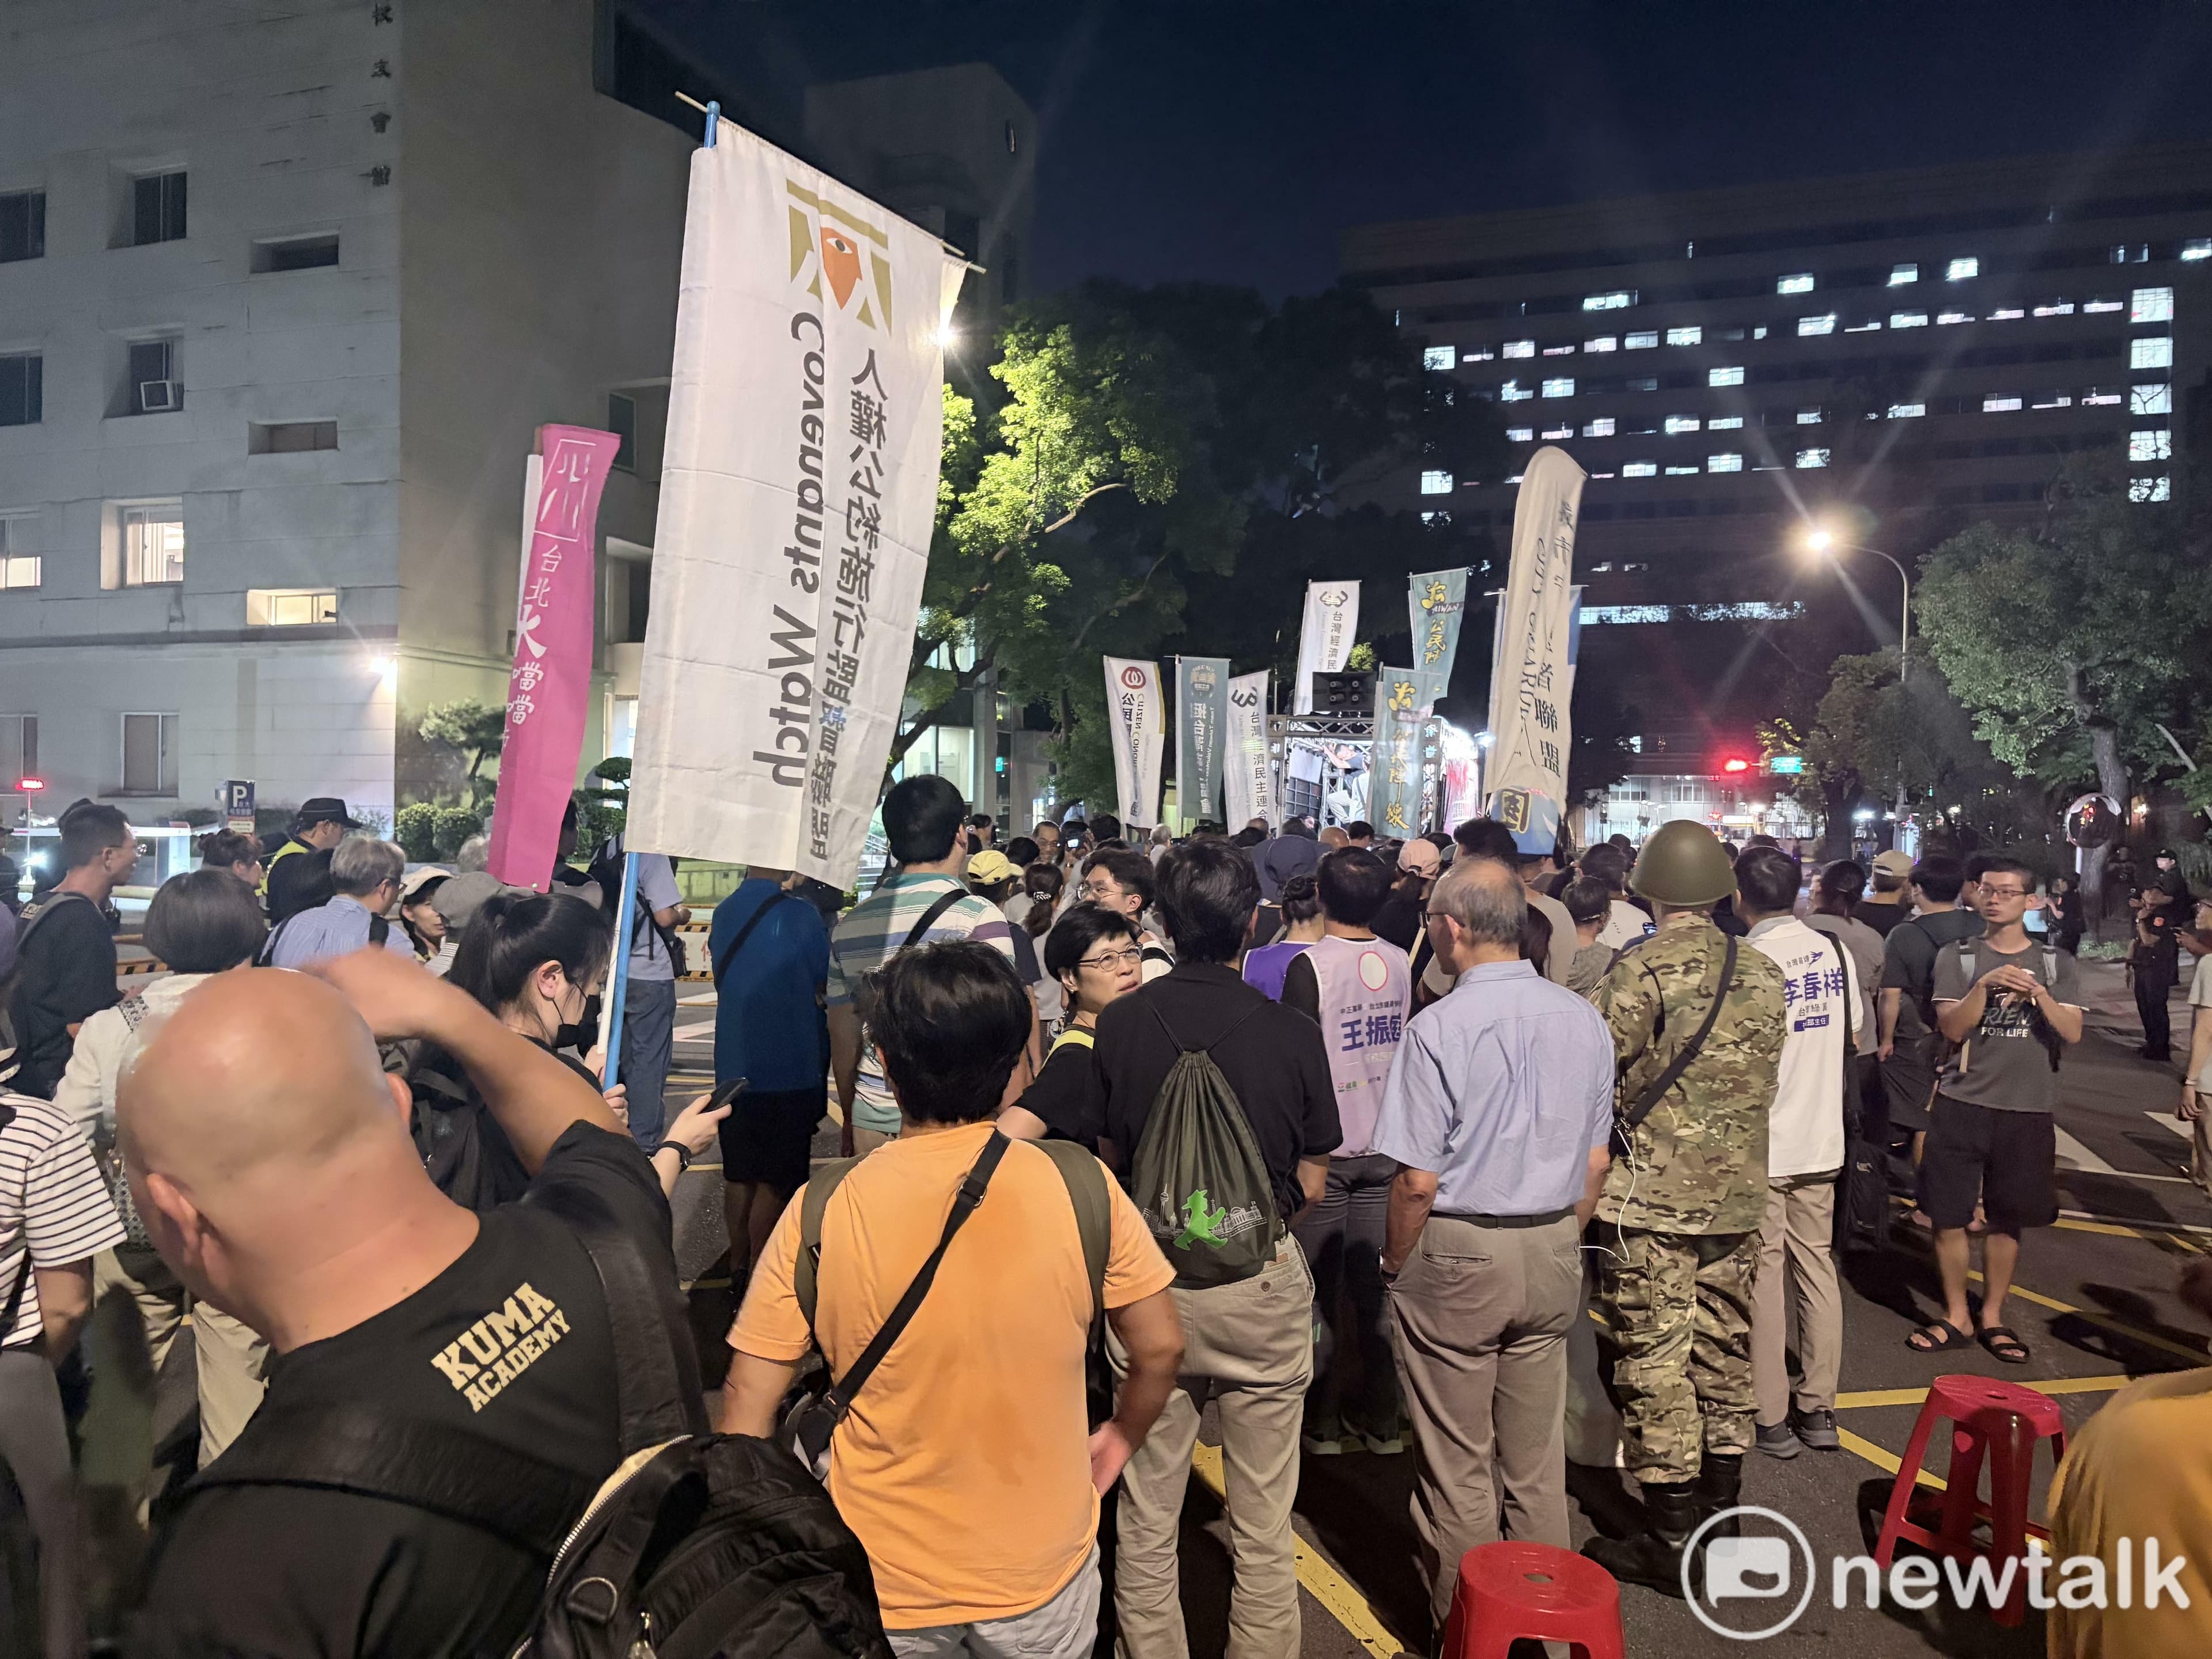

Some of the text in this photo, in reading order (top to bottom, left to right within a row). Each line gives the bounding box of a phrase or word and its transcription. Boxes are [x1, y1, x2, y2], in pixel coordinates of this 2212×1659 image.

[1423, 618, 1447, 665] 公民陣
[233, 785, 247, 808] P
[1784, 967, 1843, 1007] 李春祥
[1981, 1027, 2029, 1037] FOR LIFE
[430, 1282, 556, 1391] KUMA
[463, 1308, 571, 1414] ACADEMY
